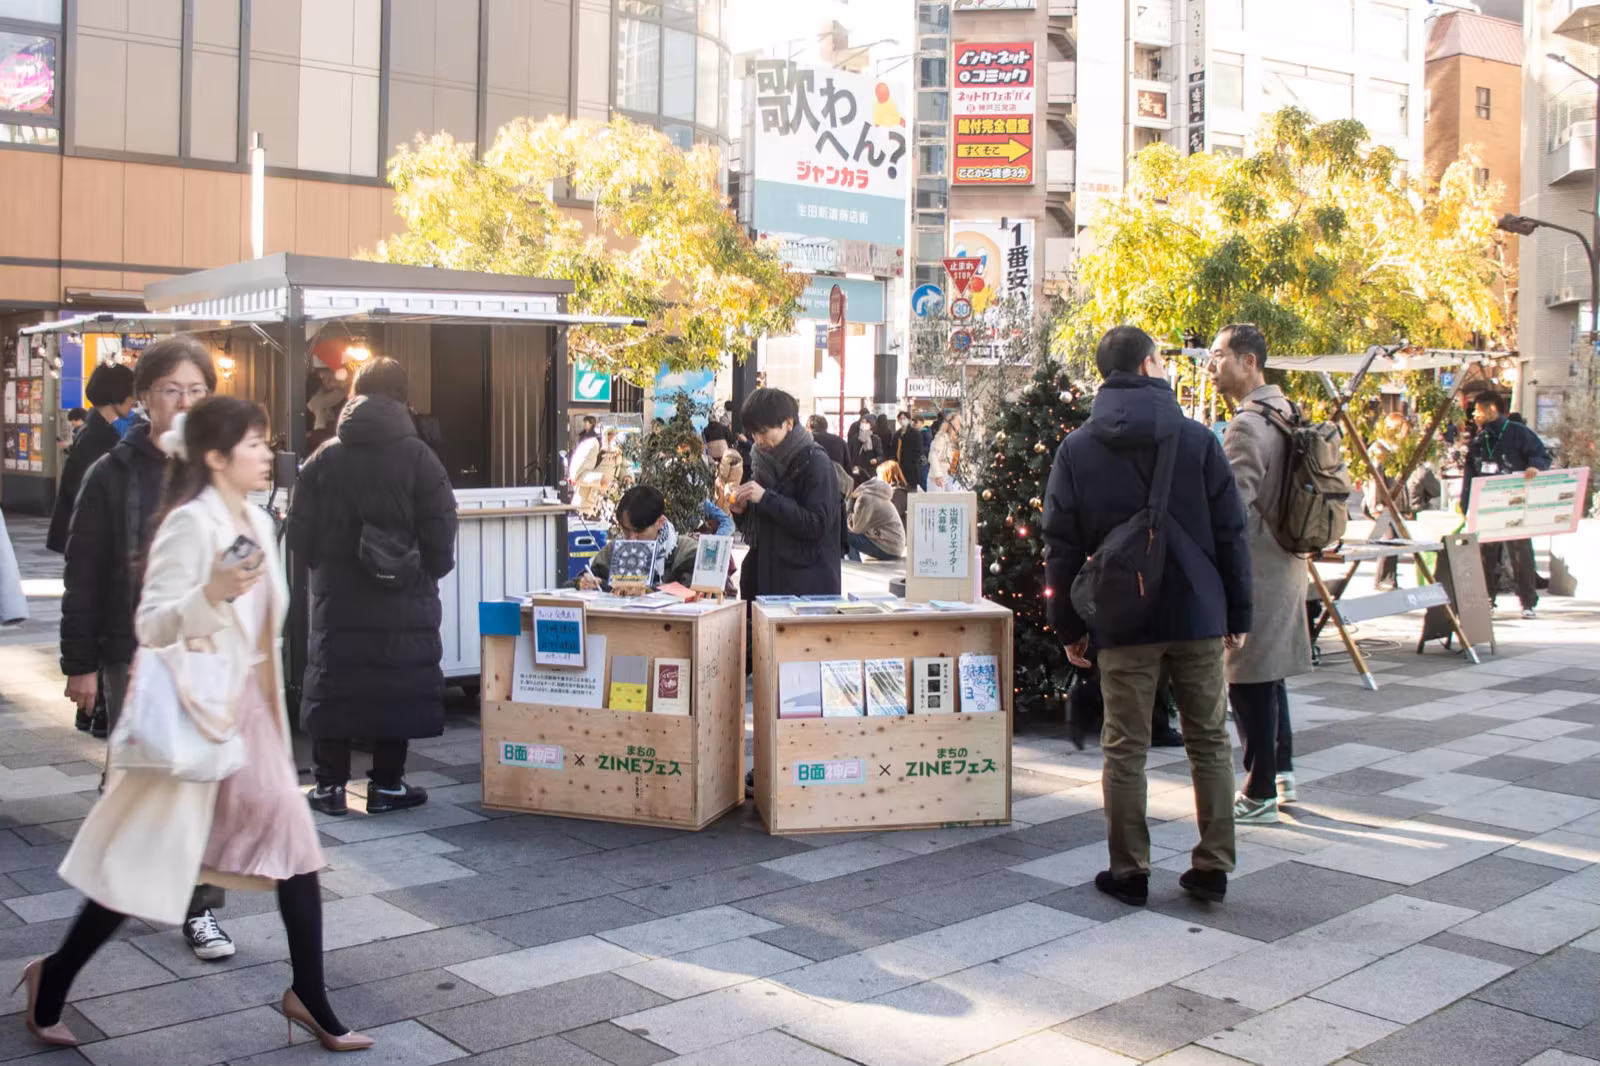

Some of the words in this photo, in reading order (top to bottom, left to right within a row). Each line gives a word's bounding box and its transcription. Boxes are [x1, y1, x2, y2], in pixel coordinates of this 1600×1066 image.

[957, 50, 1031, 66] インターネット
[756, 59, 858, 136] 歌わ
[796, 161, 869, 189] ジャンカラ
[958, 167, 1027, 179] ここから徒歩3分
[950, 262, 975, 271] 止まれ
[955, 303, 969, 315] 30
[938, 507, 947, 533] 大募集
[949, 507, 958, 573] 出展クリエイター
[504, 744, 557, 763] B面神戸
[598, 755, 682, 776] ZINEフェス
[626, 745, 656, 757] まちの
[937, 747, 968, 759] まちの
[798, 762, 859, 781] B面神戸
[905, 759, 996, 777] ZINEフェス
